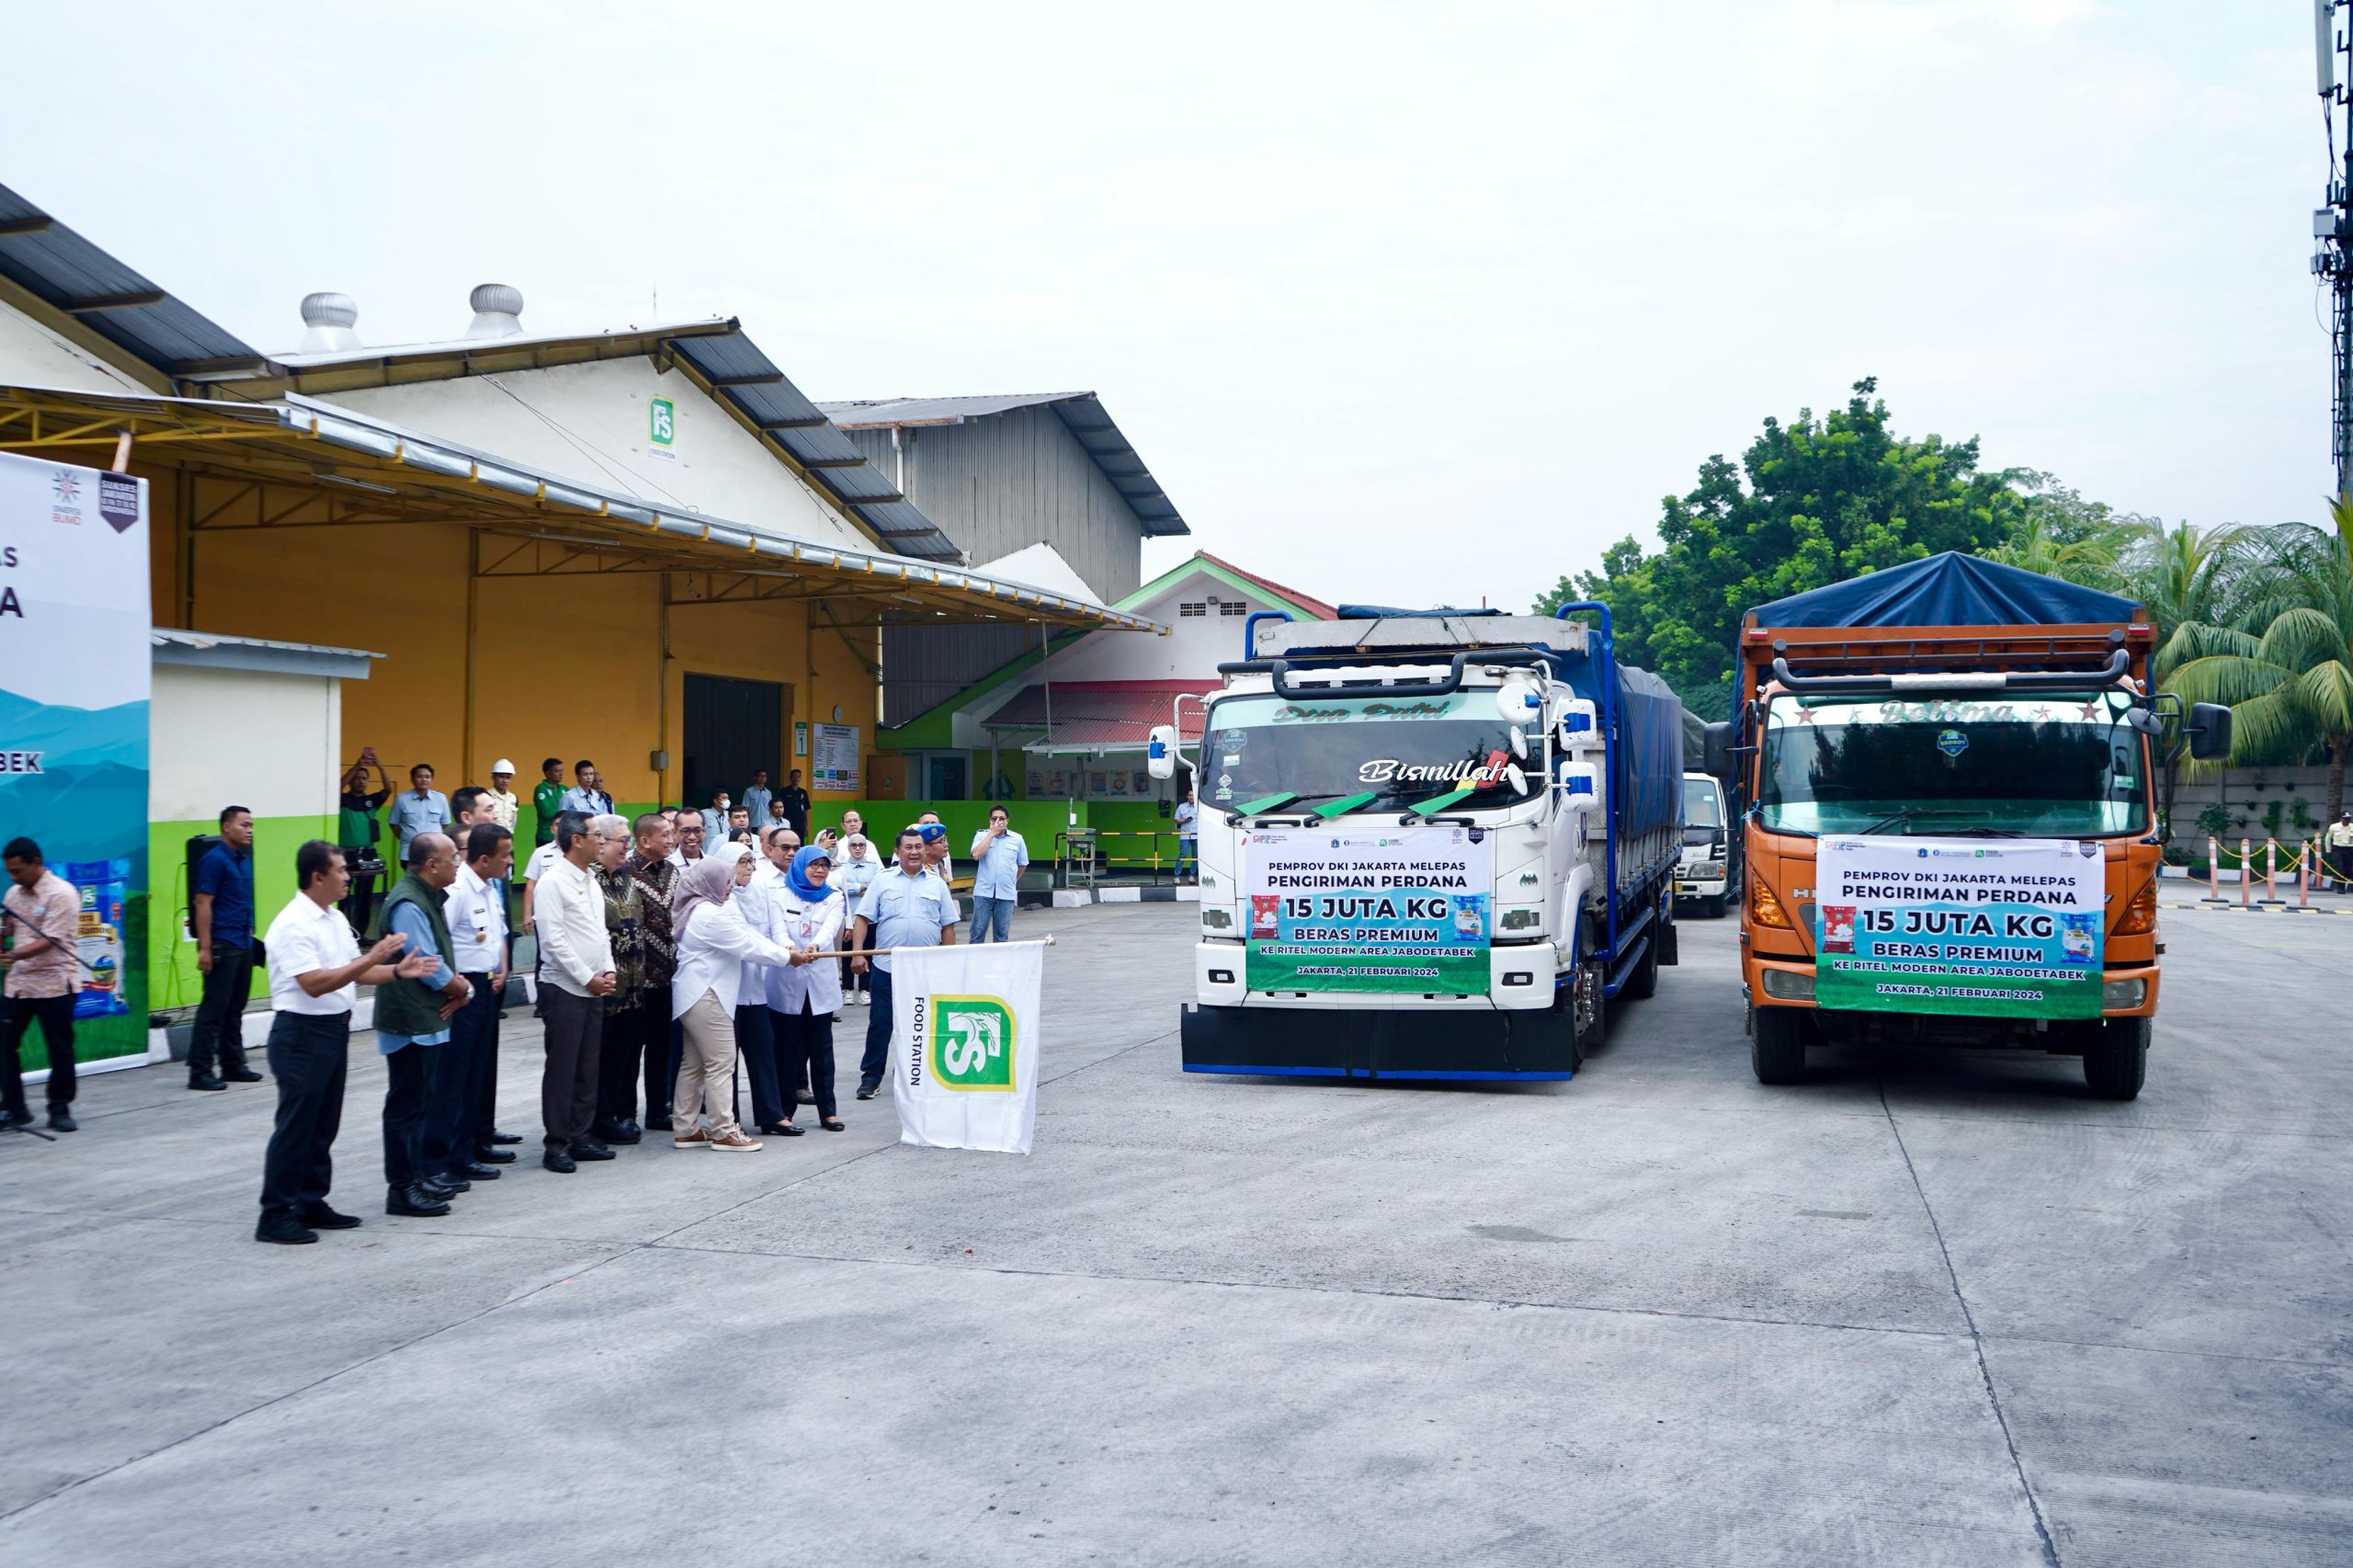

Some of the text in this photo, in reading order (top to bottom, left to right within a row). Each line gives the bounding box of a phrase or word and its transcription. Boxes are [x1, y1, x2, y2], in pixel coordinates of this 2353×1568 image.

[0, 546, 18, 568] S
[1358, 759, 1509, 783] Bismillah
[1268, 862, 1466, 870] PEMPROV DKI JAKARTA MELEPAS
[1267, 875, 1468, 888] PENGIRIMAN PERDANA
[1844, 870, 2076, 887] PEMPROV DKI JAKARTA MELEPAS
[1842, 884, 2077, 905] PENGIRIMAN PERDANA
[1286, 898, 1447, 919] 15 JUTA KG
[1863, 910, 2052, 937] 15 JUTA KG
[1294, 928, 1438, 941] BERAS PREMIUM
[1261, 946, 1274, 954] KE
[1310, 947, 1356, 955] MODERN
[1359, 947, 1389, 955] AREA
[1392, 948, 1475, 958] JABODETABEK
[1874, 942, 2042, 962] BERAS PREMIUM
[1298, 967, 1346, 977] JAKARTA,
[1348, 967, 1358, 975] 21
[1835, 960, 2086, 981] KE RITEL MODERN AREA JABODETABEK
[1878, 984, 2043, 1000] JAKARTA, 21 FEBRUARI 2024
[910, 996, 925, 1086] FOOD STATION
